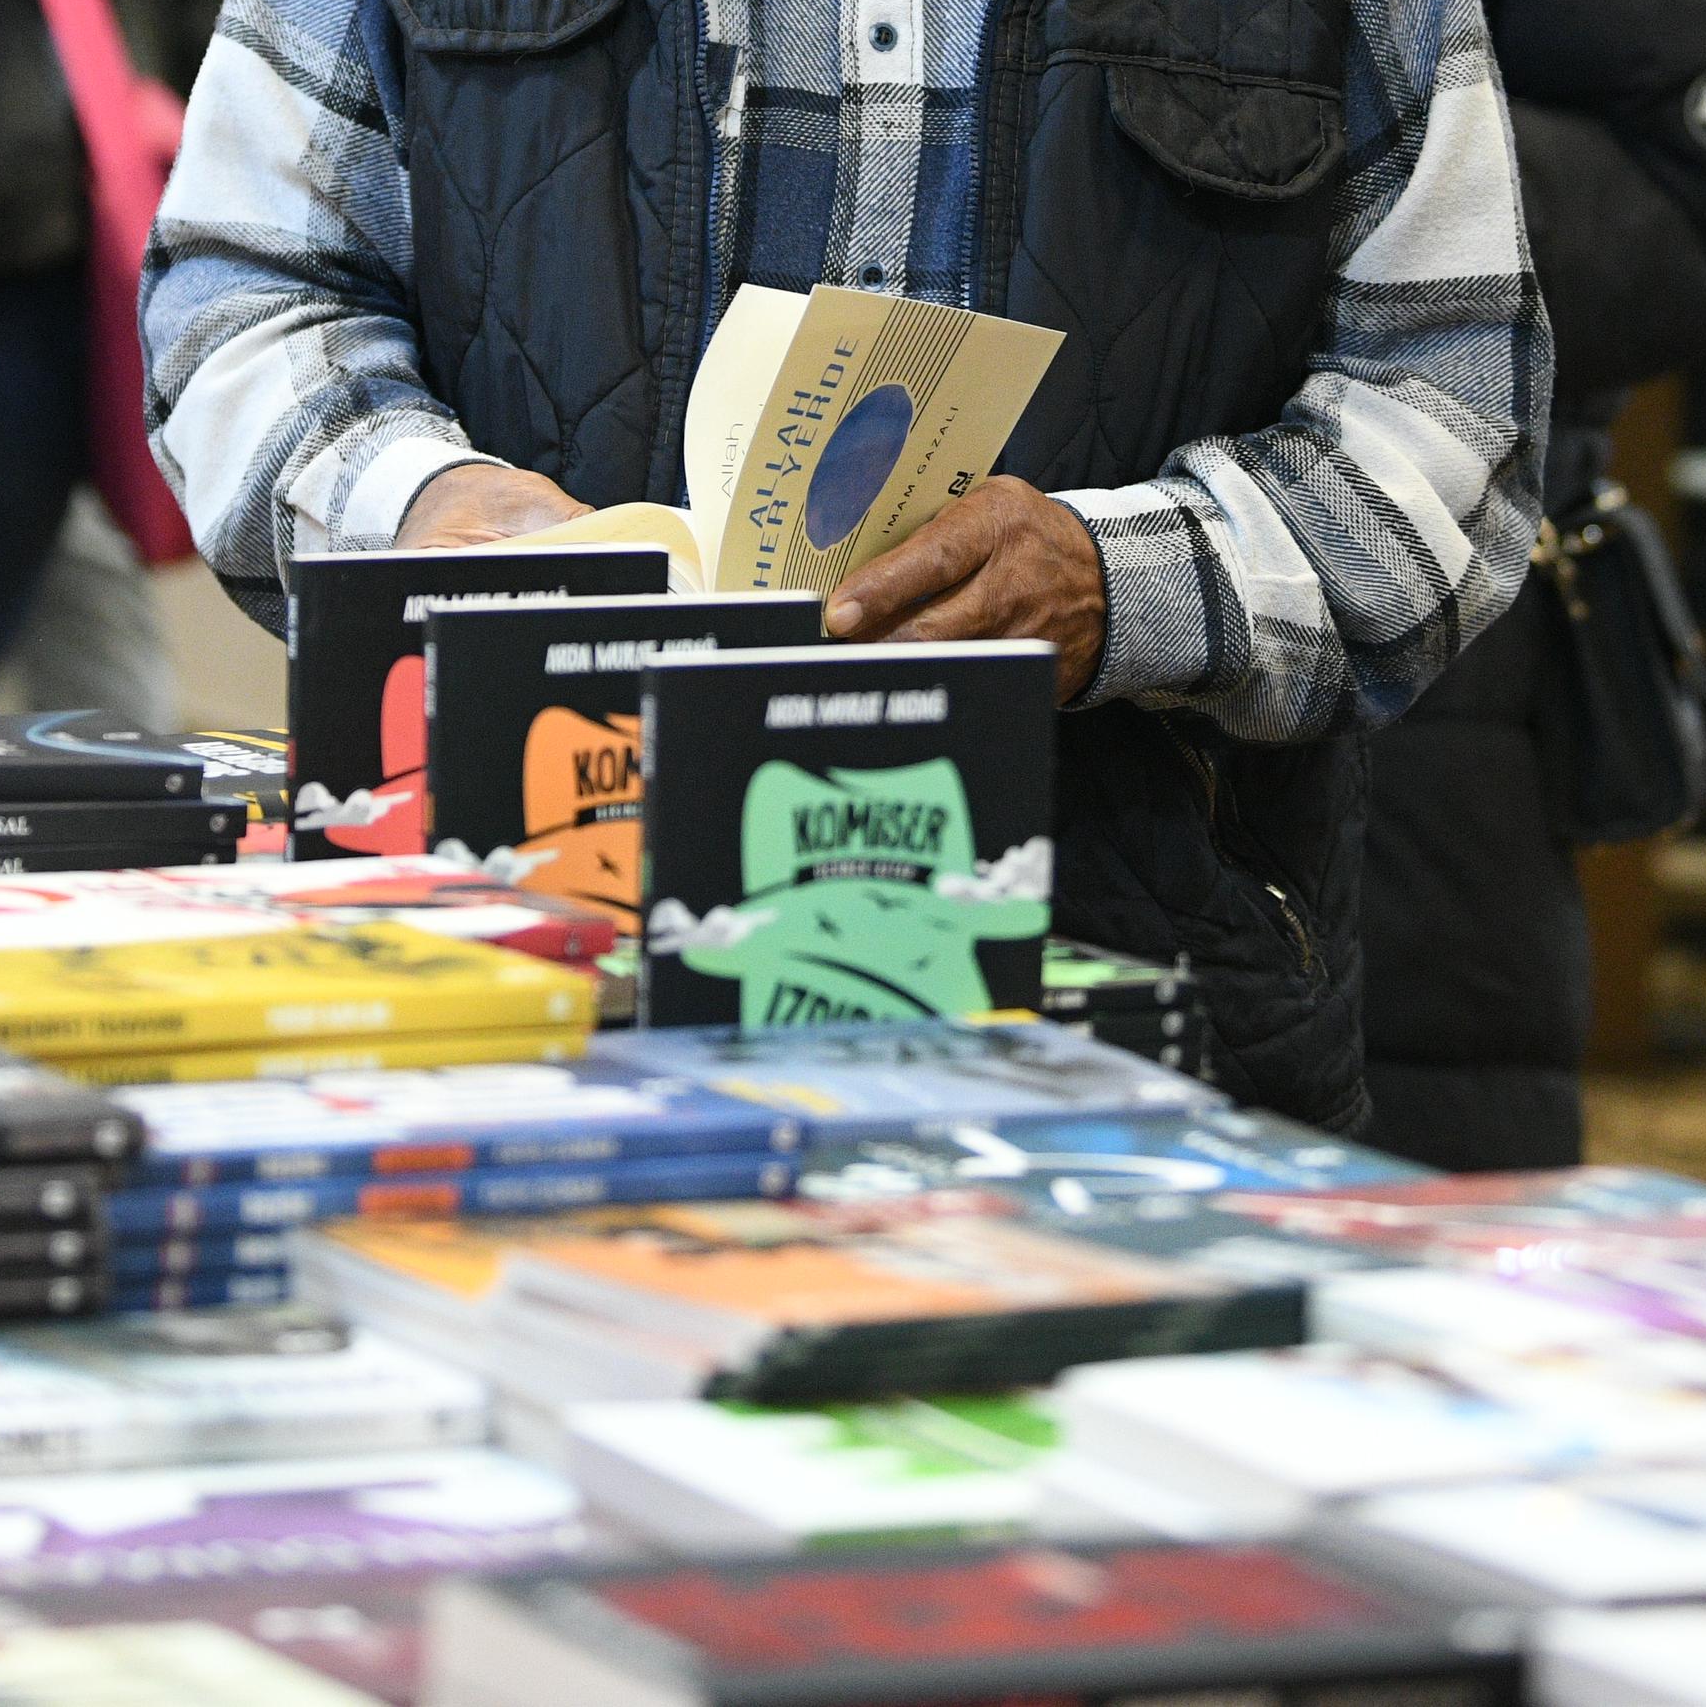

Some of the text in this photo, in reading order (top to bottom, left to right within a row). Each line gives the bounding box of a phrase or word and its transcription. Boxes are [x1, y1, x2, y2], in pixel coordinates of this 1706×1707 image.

[721, 423, 744, 499] Allah
[749, 390, 811, 529] ALLAH
[753, 336, 860, 588] HER YERDE
[544, 643, 593, 674] ARDA
[764, 694, 817, 730] ARDA
[817, 691, 885, 727] MURAT
